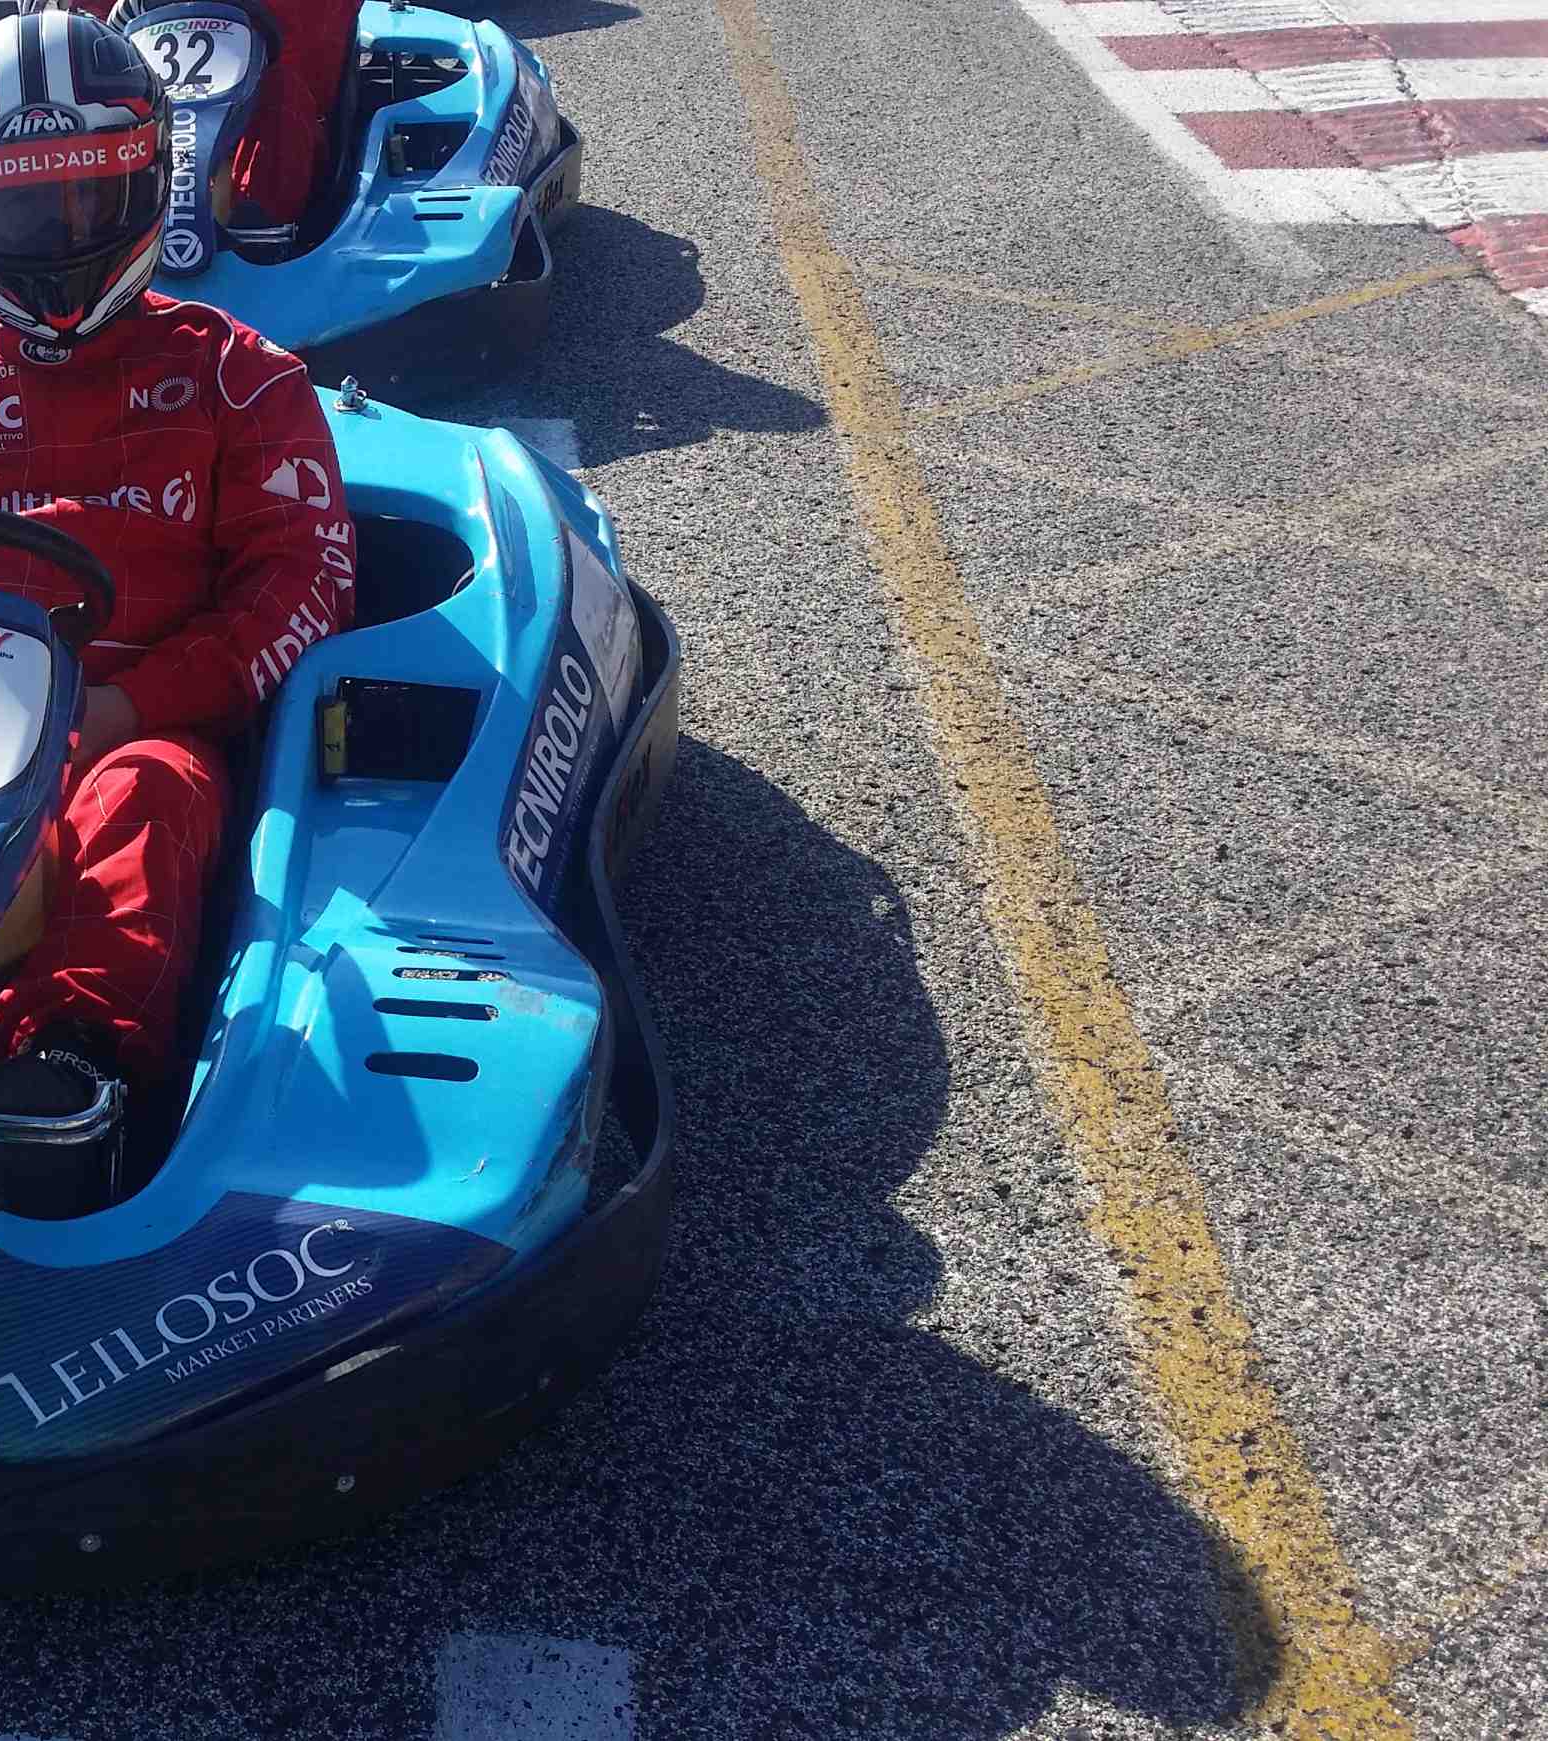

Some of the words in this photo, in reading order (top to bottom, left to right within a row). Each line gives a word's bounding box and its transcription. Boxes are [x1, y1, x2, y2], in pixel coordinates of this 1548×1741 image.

[154, 31, 214, 87] 32
[3, 110, 75, 138] Airoh
[164, 1327, 256, 1386] MARKET
[262, 1275, 374, 1338] PARTNERS
